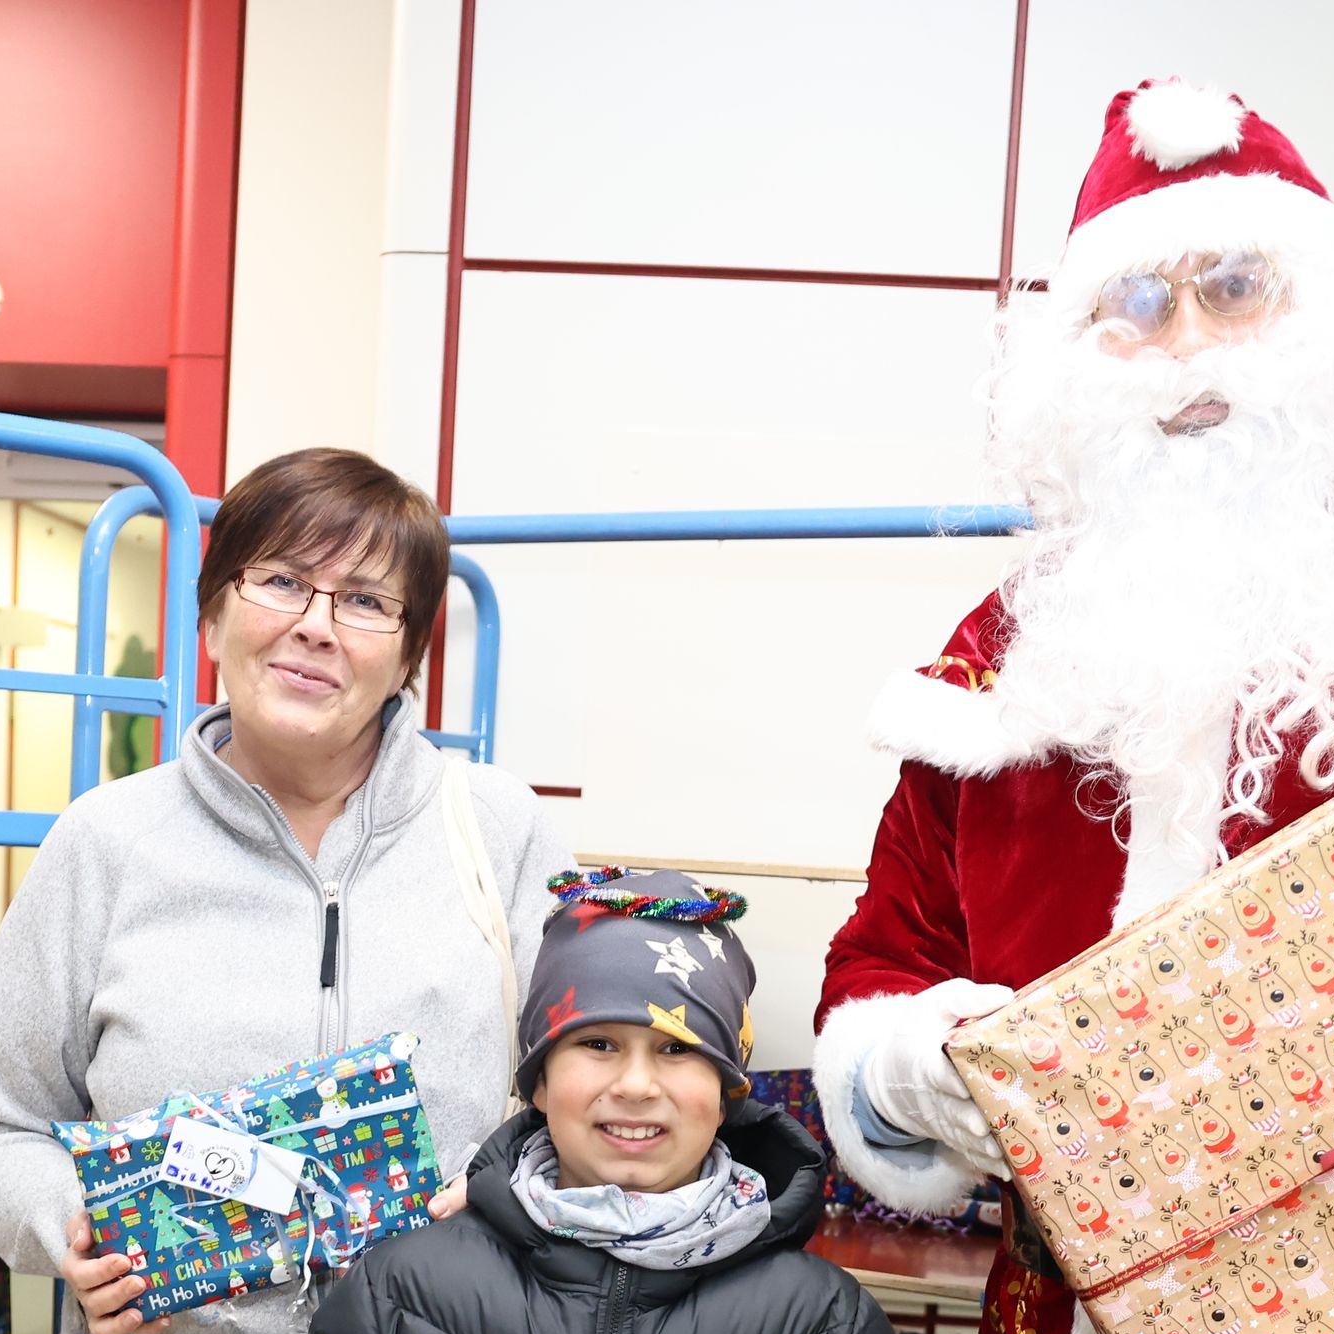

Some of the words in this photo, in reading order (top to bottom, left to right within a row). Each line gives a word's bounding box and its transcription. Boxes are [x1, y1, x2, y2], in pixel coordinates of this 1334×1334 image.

[174, 1240, 262, 1281] CHRISTMAS
[148, 1293, 171, 1311] Ho
[171, 1286, 194, 1304] Ho
[194, 1279, 217, 1297] Ho
